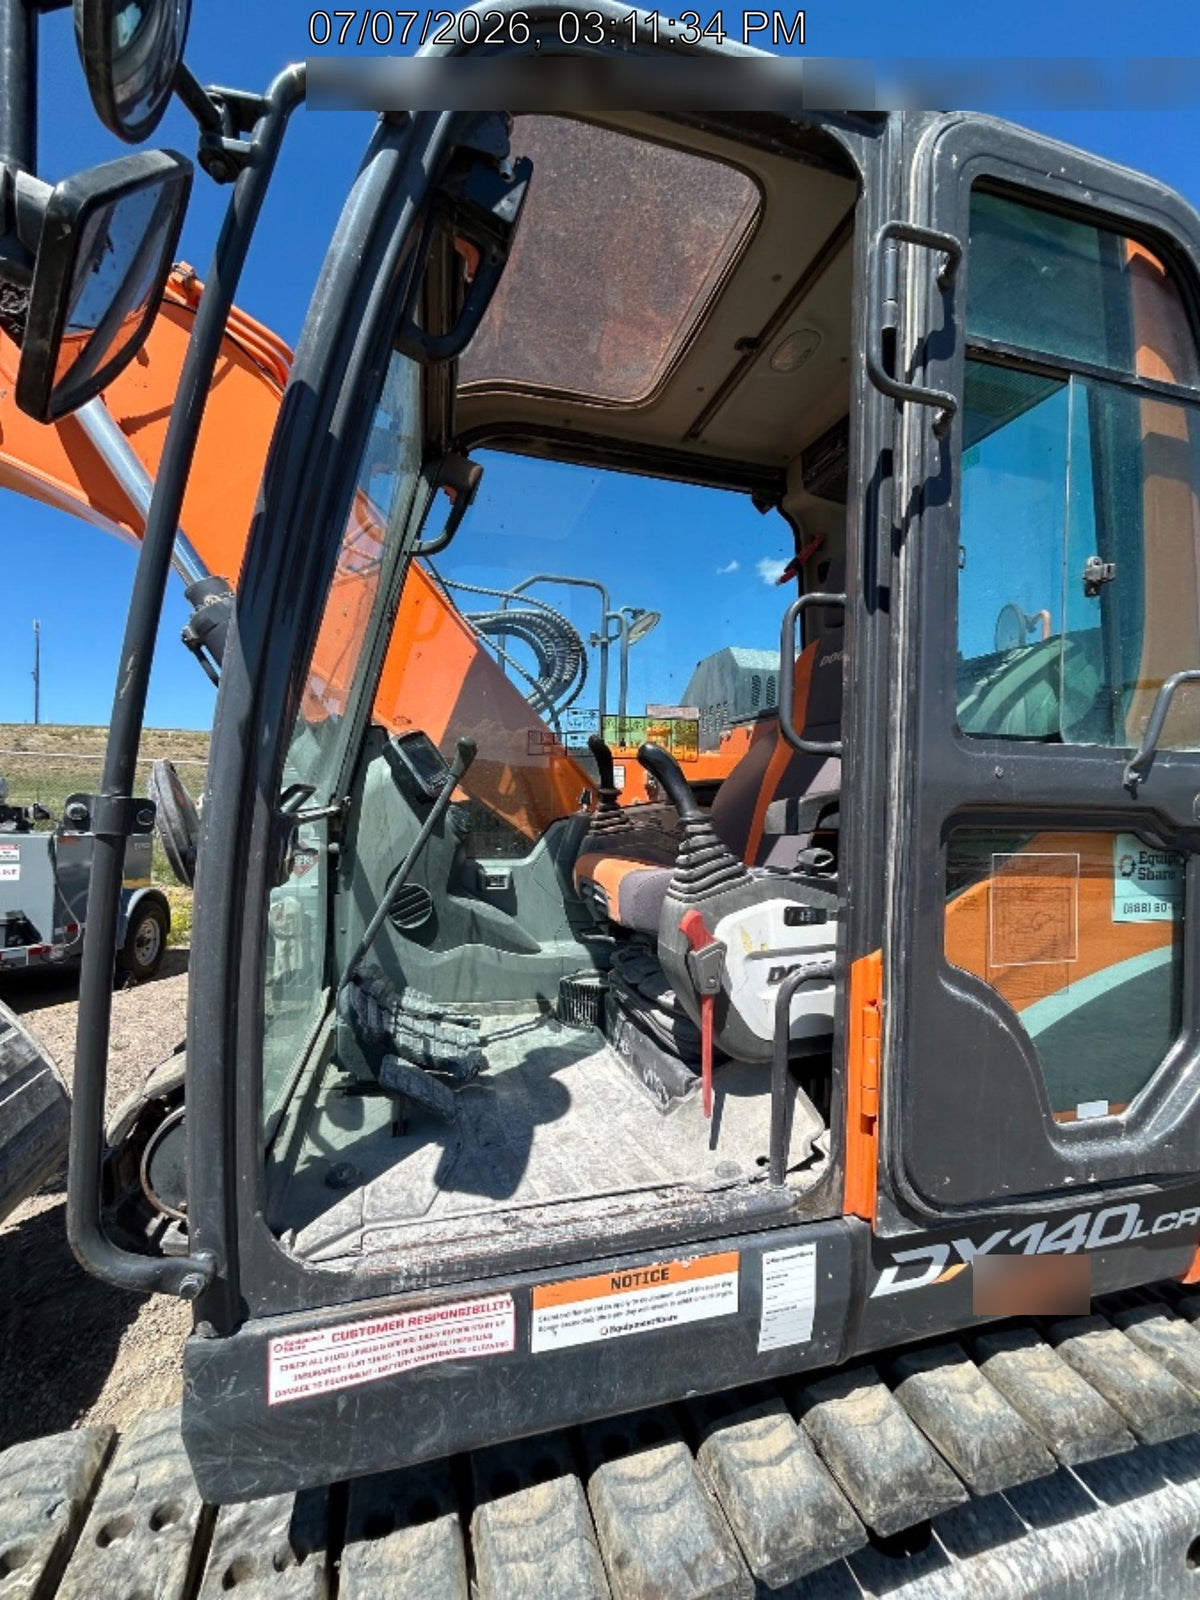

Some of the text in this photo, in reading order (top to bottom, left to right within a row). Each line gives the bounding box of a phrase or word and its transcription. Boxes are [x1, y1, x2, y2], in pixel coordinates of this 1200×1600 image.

[1138, 867, 1176, 881] Share
[611, 1267, 669, 1290] NOTICE
[331, 1320, 404, 1341] CUSTOMER
[408, 1300, 511, 1326] RESPONSIBILITY
